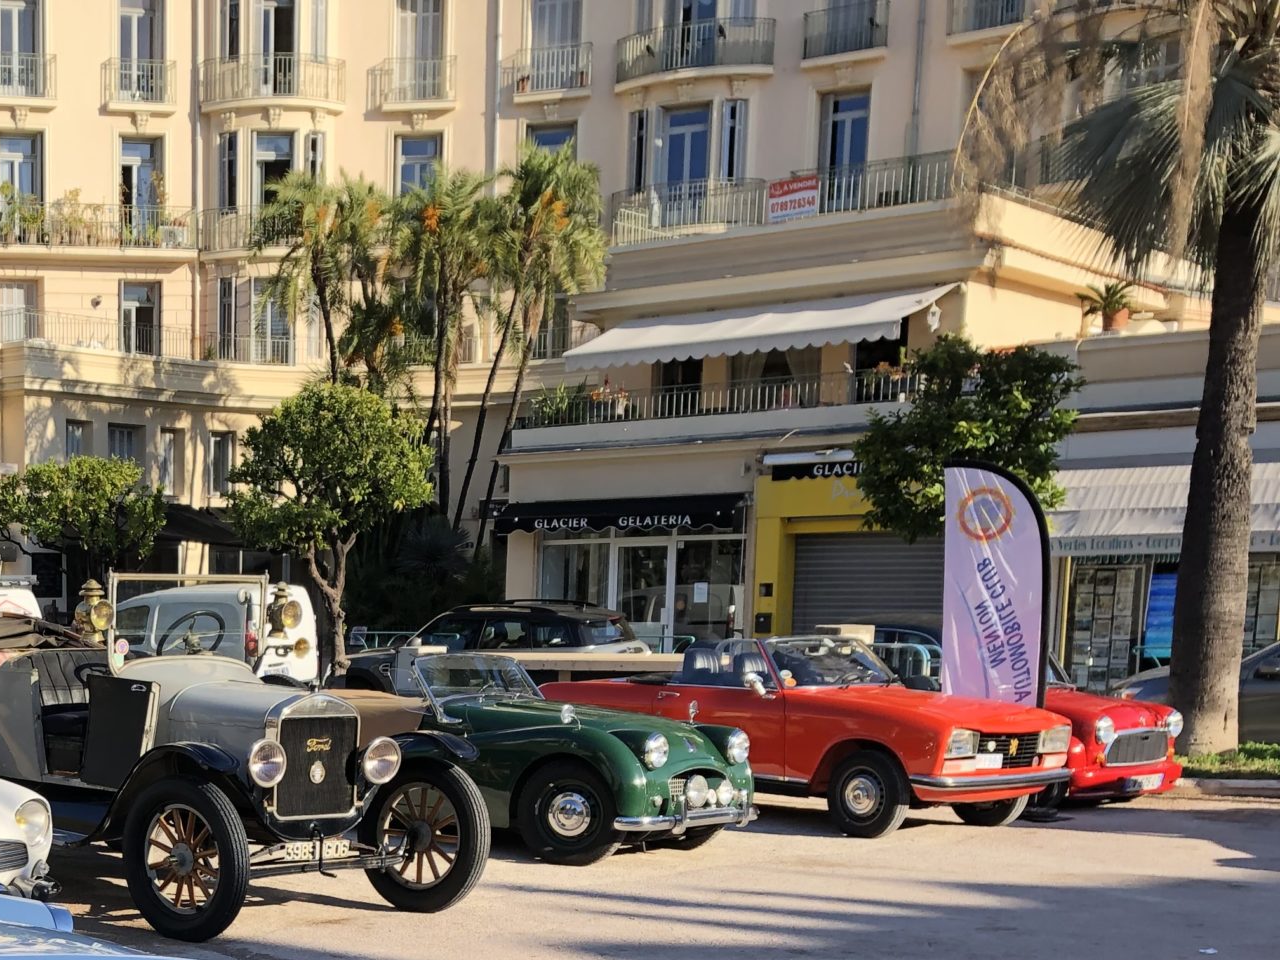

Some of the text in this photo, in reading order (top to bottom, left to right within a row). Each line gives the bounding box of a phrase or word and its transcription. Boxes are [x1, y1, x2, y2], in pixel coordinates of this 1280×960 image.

[534, 514, 692, 529] GLACIER GELATERIA
[306, 737, 332, 752] Ford
